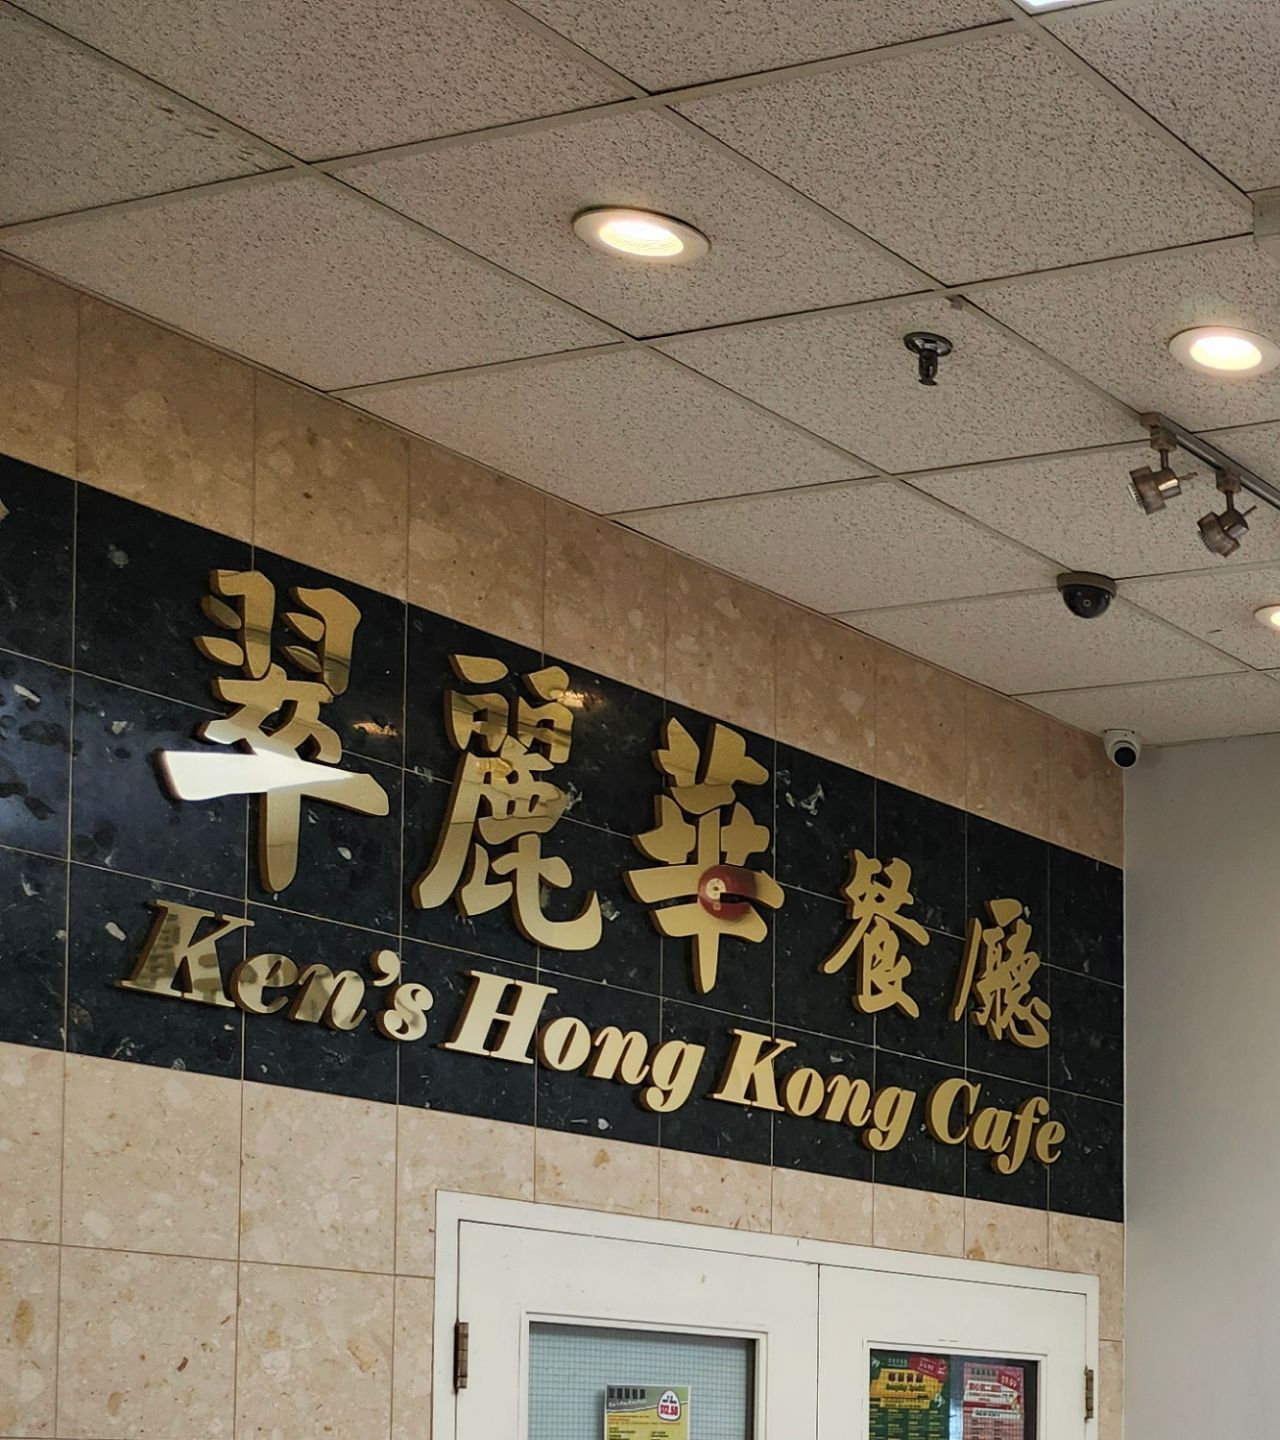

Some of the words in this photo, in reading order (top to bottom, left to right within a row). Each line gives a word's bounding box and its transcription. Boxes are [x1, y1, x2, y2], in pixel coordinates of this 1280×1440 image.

[153, 568, 1055, 1050] 翠麗華餐廳
[114, 898, 435, 1043] Ken's
[442, 968, 707, 1113] Hong
[710, 1027, 918, 1152] Kong
[925, 1077, 1068, 1176] Cafe
